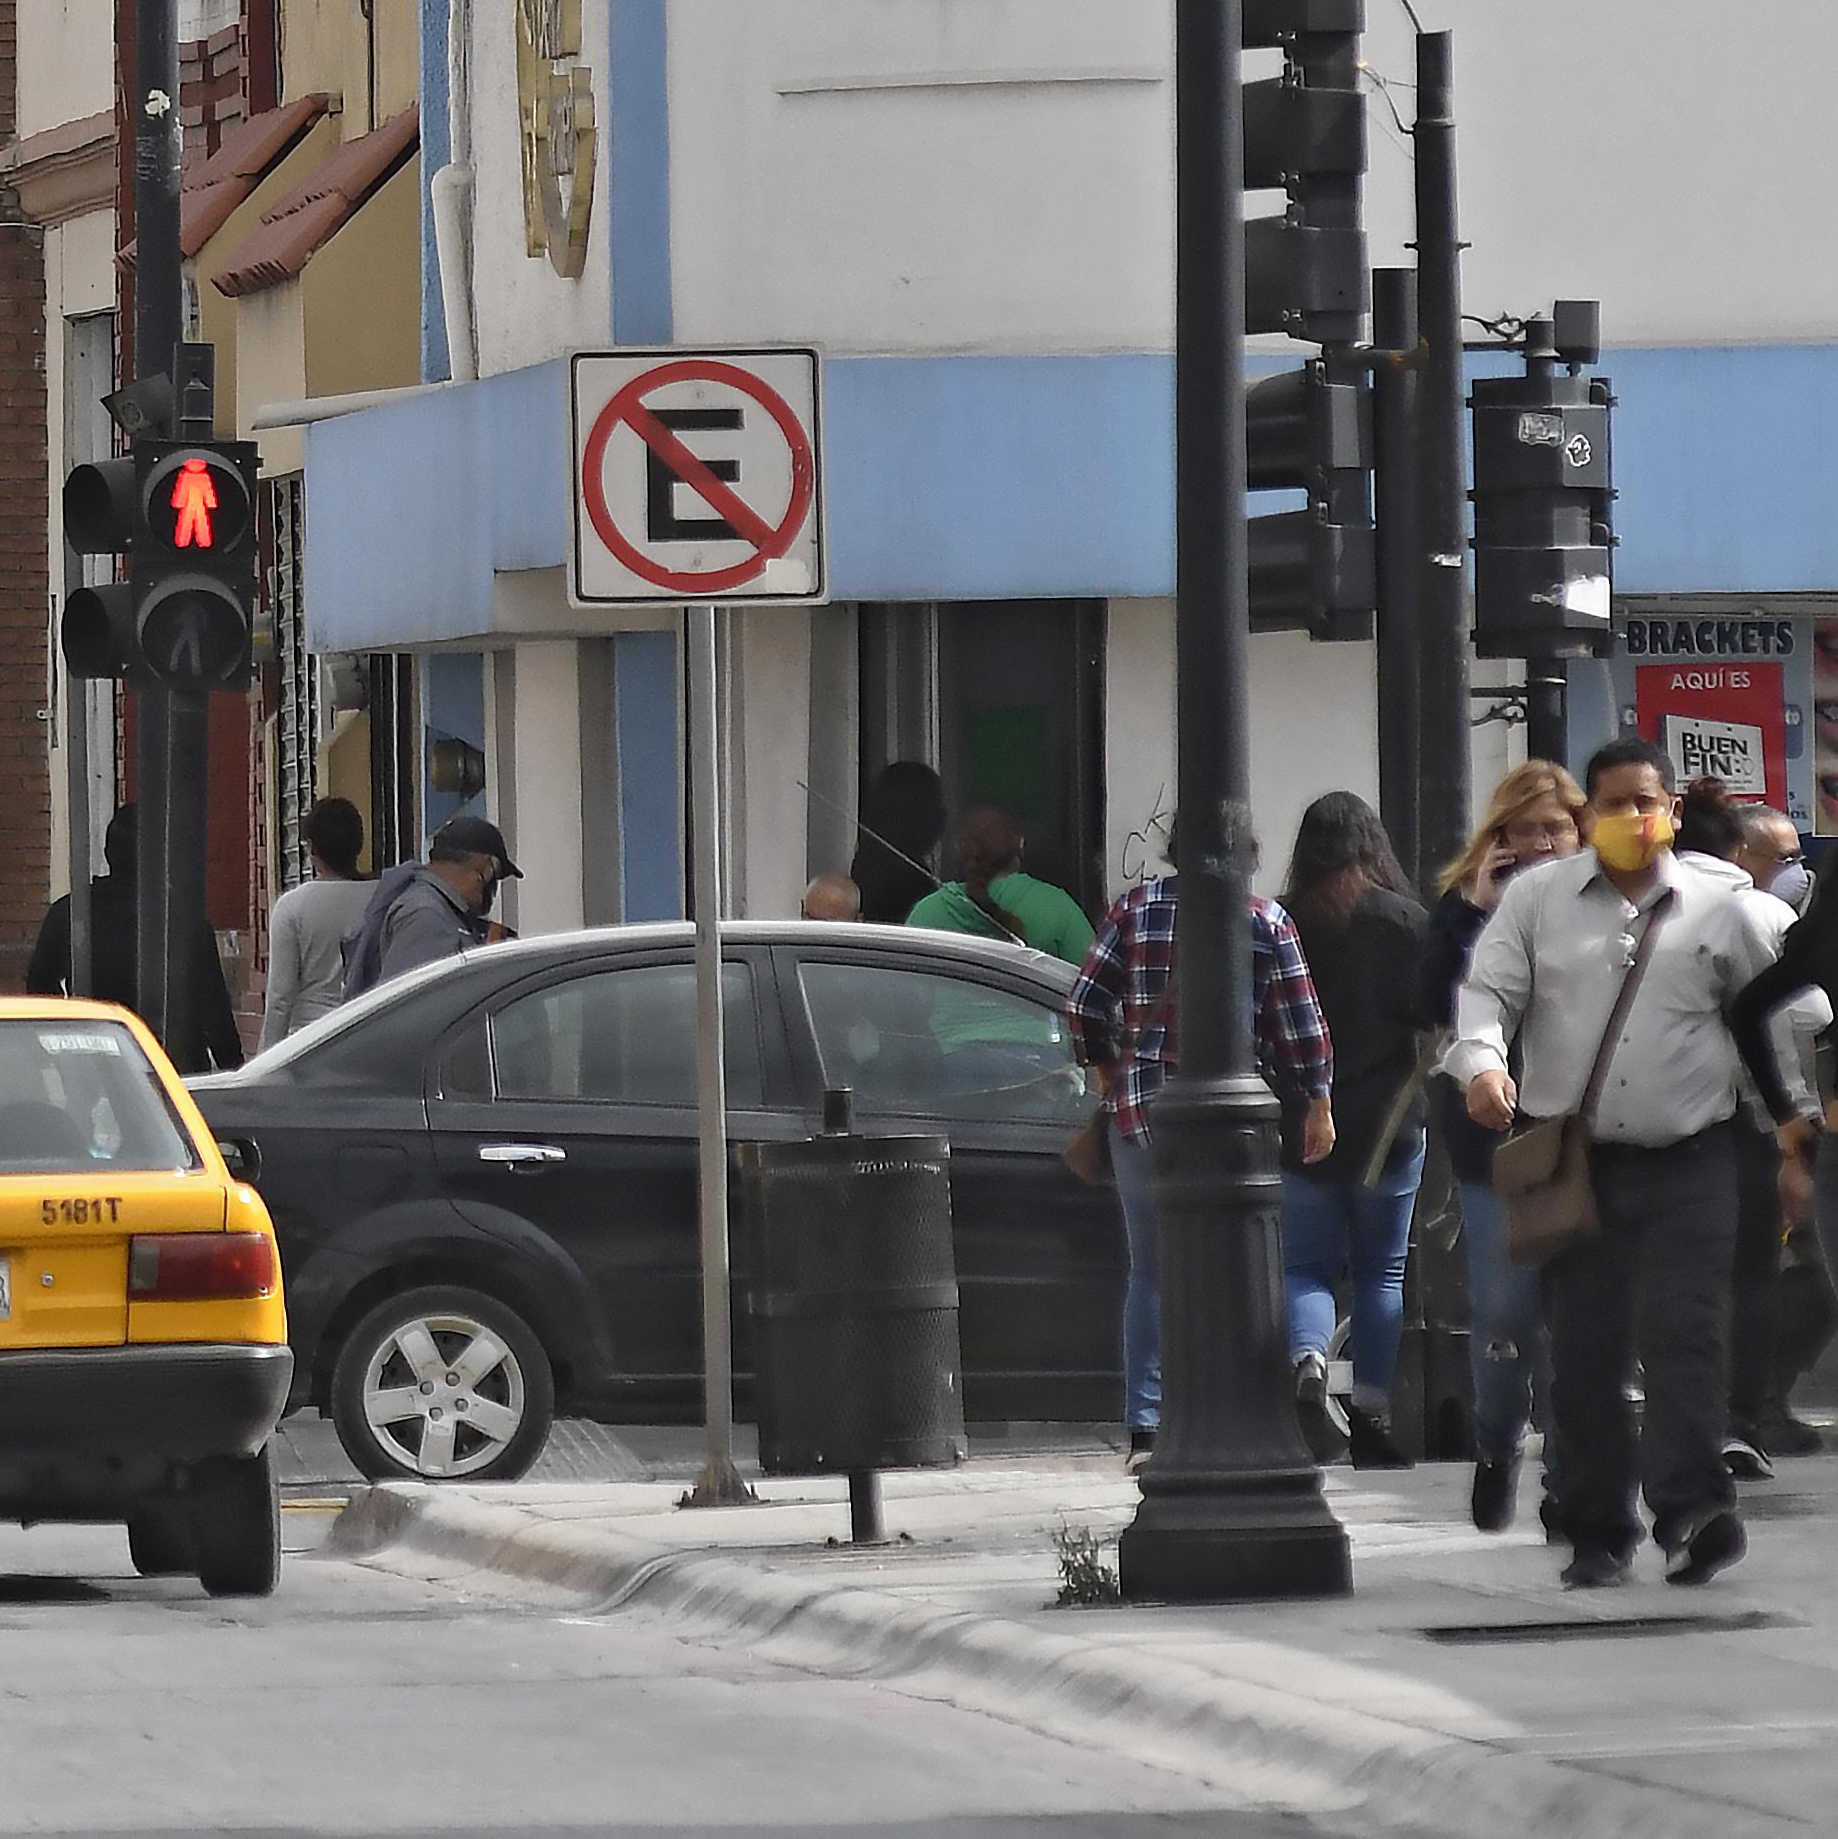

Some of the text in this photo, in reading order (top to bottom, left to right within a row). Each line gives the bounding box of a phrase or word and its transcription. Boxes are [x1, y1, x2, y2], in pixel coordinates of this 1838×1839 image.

[1626, 619, 1794, 655] BRACKETS
[1671, 668, 1751, 691] AQUÍ ES
[1682, 732, 1748, 755] BUEN
[42, 1197, 122, 1225] 5181T
